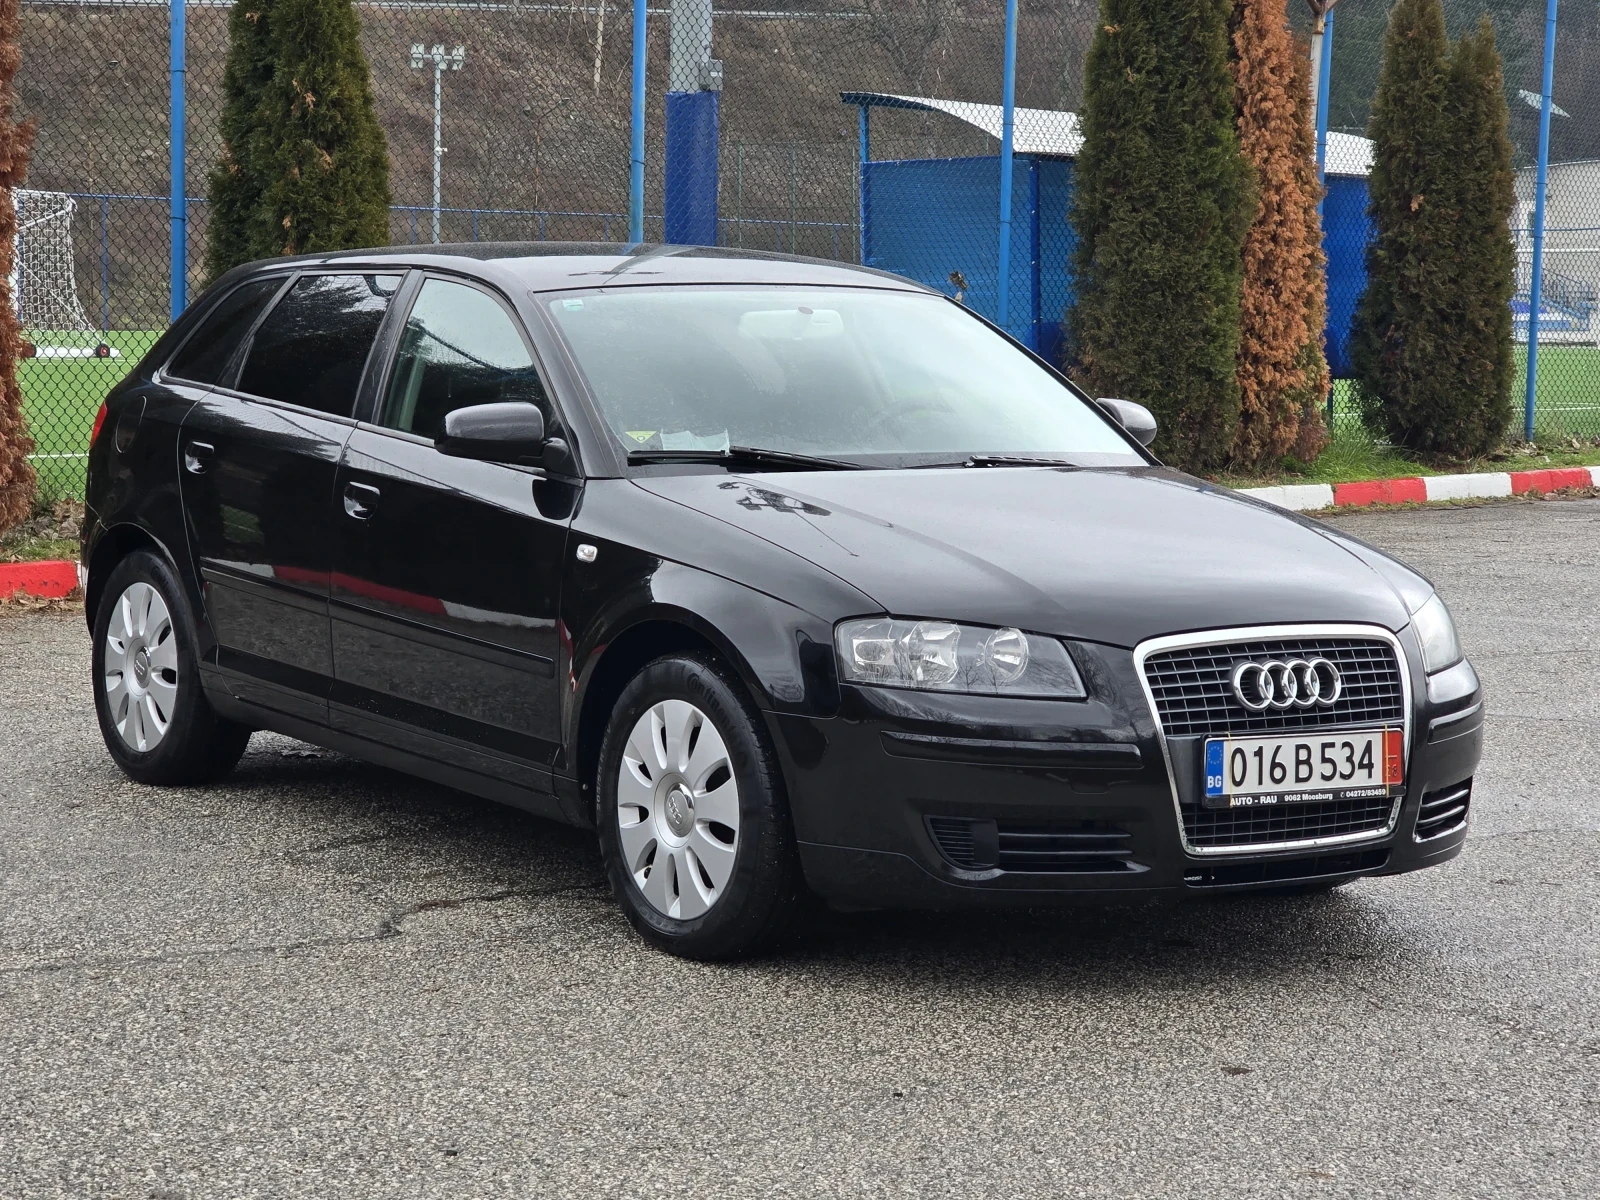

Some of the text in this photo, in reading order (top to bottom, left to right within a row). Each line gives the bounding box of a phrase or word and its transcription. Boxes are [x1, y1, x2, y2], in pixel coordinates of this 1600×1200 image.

[1231, 740, 1374, 787] 016B534
[1207, 775, 1222, 788] BG
[1230, 796, 1253, 806] AUTO
[1260, 795, 1278, 804] RAU
[1284, 793, 1301, 802] 9062
[1302, 792, 1333, 801] Moosburg
[1345, 788, 1386, 798] 04272/83459
